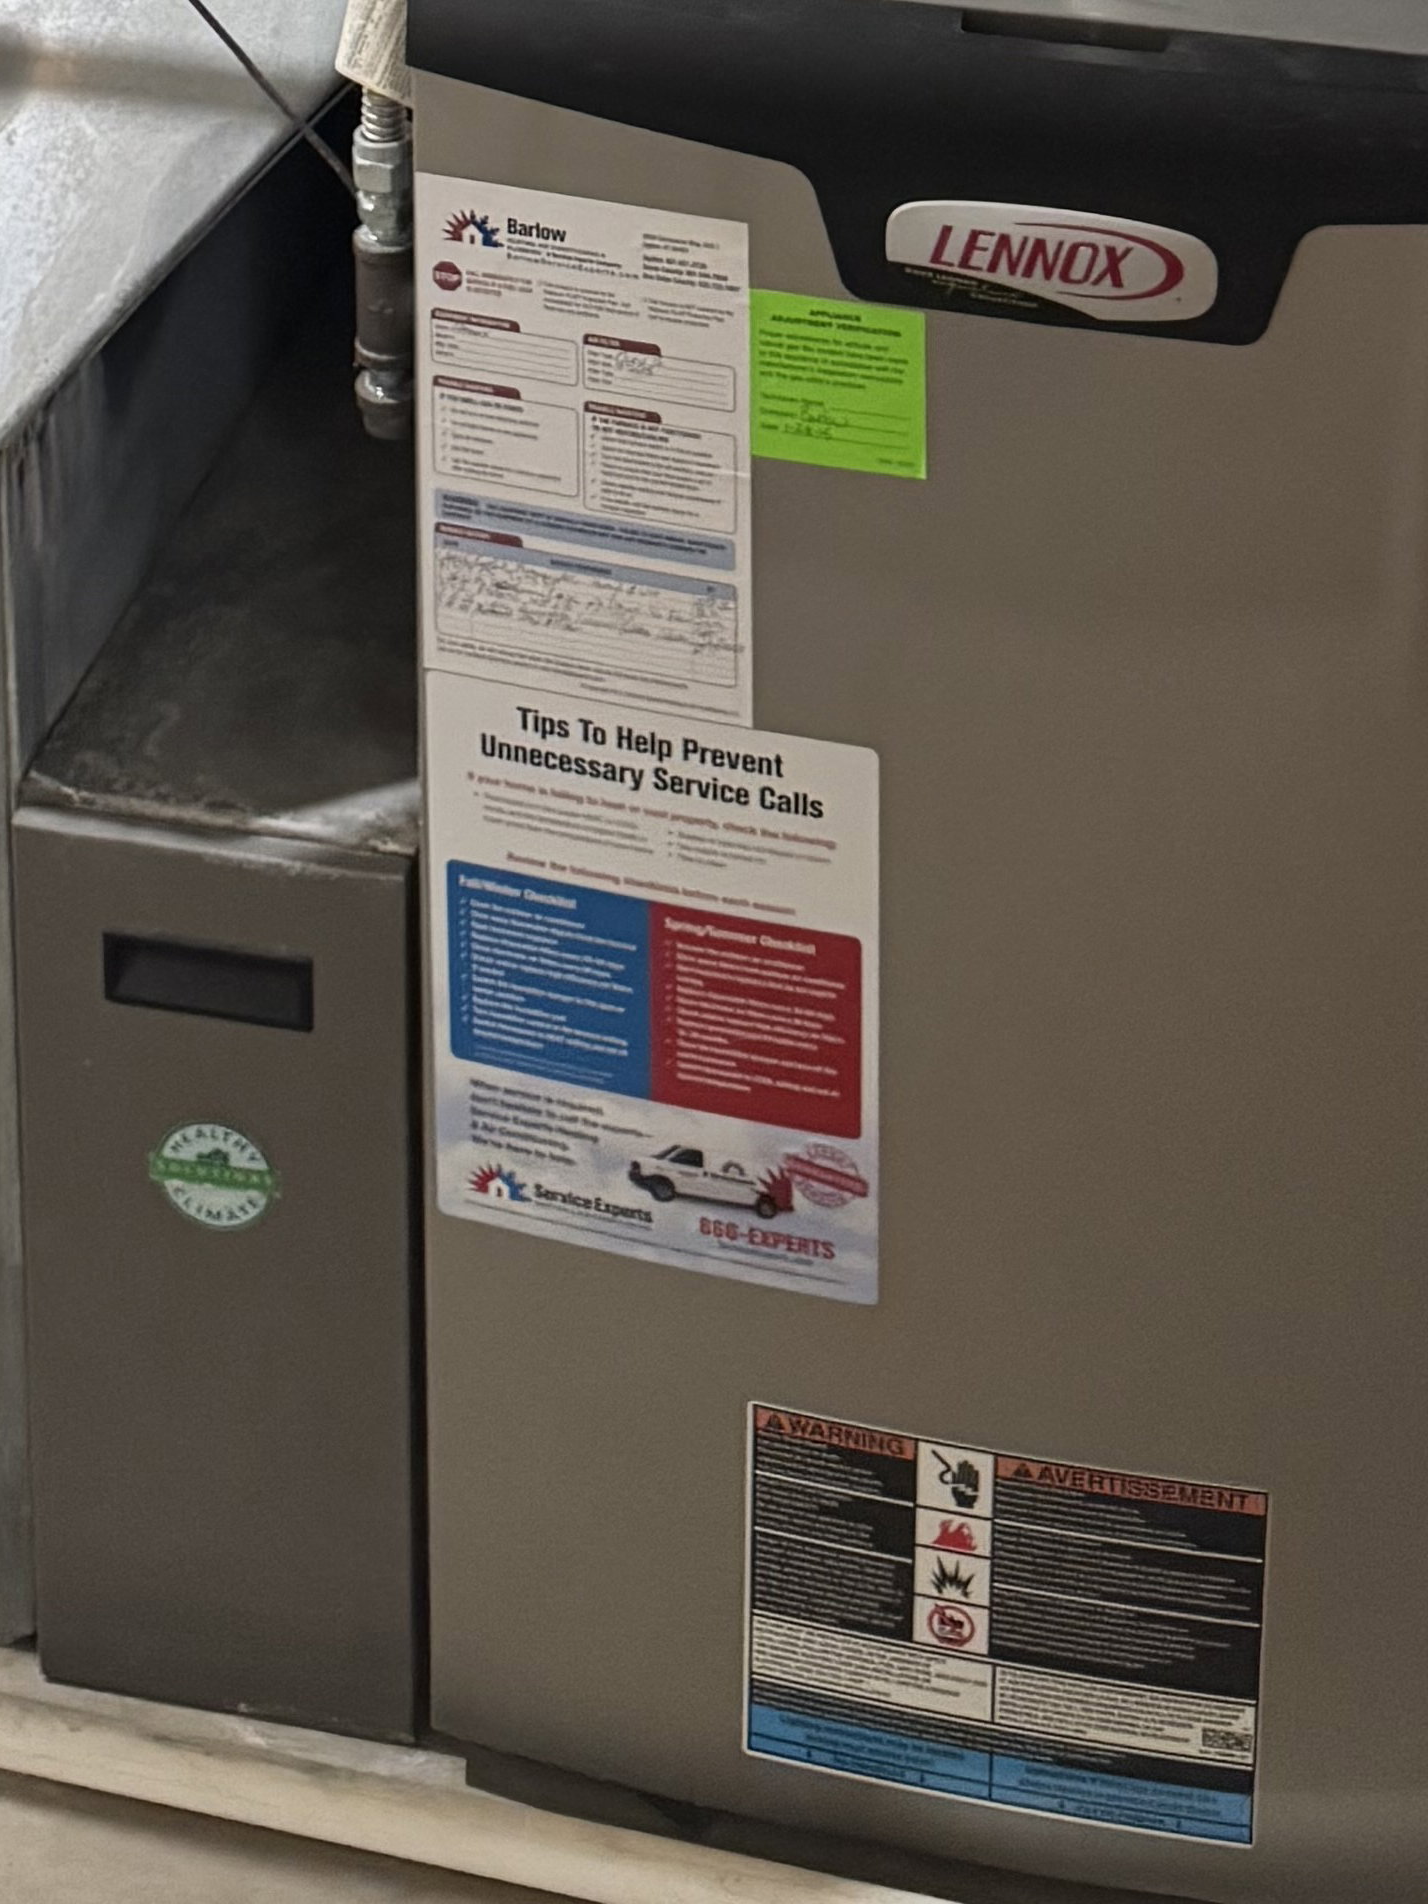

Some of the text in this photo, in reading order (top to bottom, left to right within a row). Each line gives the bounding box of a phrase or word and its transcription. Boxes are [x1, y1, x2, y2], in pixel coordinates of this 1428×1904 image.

[506, 217, 567, 243] Barlow
[929, 225, 1134, 289] LENNOX
[517, 706, 784, 779] Tips To Help Prevent
[481, 733, 825, 820] Unnecessary Service Calls
[788, 1416, 906, 1458] WARNING
[1036, 1464, 1251, 1513] AVERTISSEMENT
